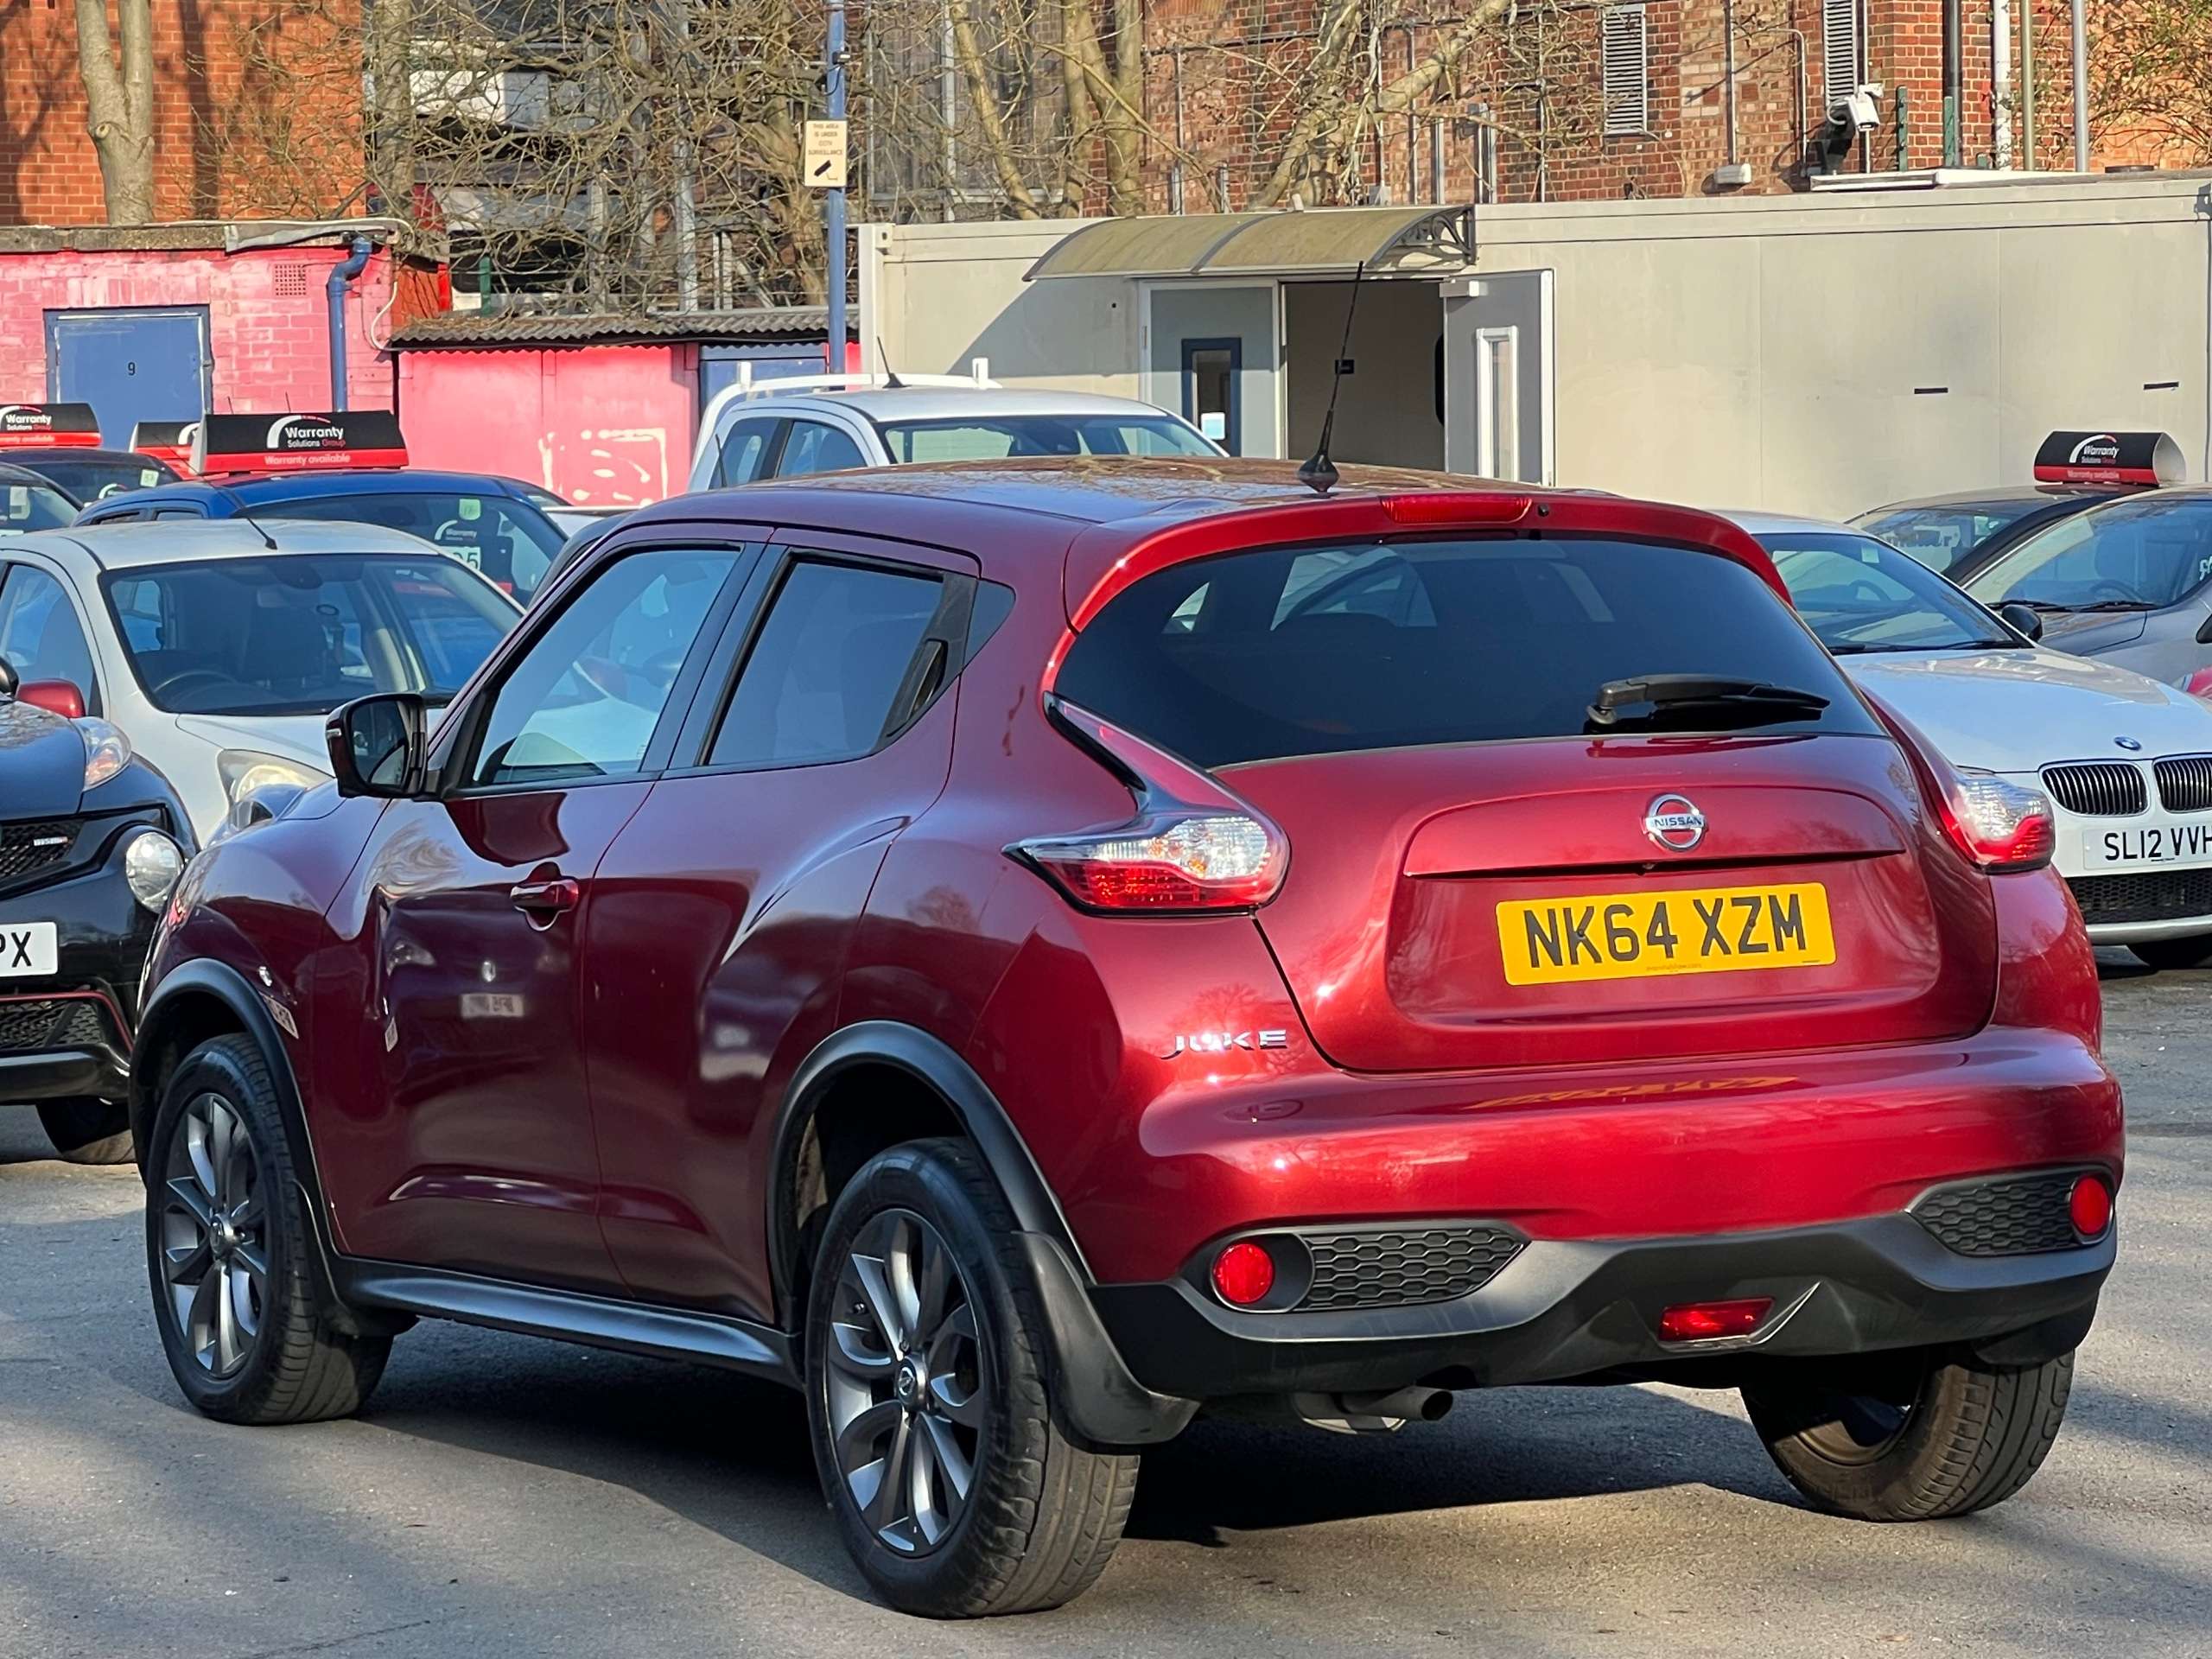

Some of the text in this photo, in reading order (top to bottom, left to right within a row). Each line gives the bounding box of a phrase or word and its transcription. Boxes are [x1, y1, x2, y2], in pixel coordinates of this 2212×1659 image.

[128, 362, 136, 376] 9
[5, 415, 52, 425] Warranty
[285, 426, 344, 440] Warranty
[287, 439, 321, 448] Solutions
[2083, 445, 2120, 459] Warranty
[264, 453, 351, 467] Warranty available
[1654, 816, 1702, 827] NISSAN
[2104, 830, 2162, 861] SL12
[1523, 893, 1807, 969] NK64 XZM
[0, 931, 32, 969] X
[1160, 1029, 1287, 1060] JUKE
